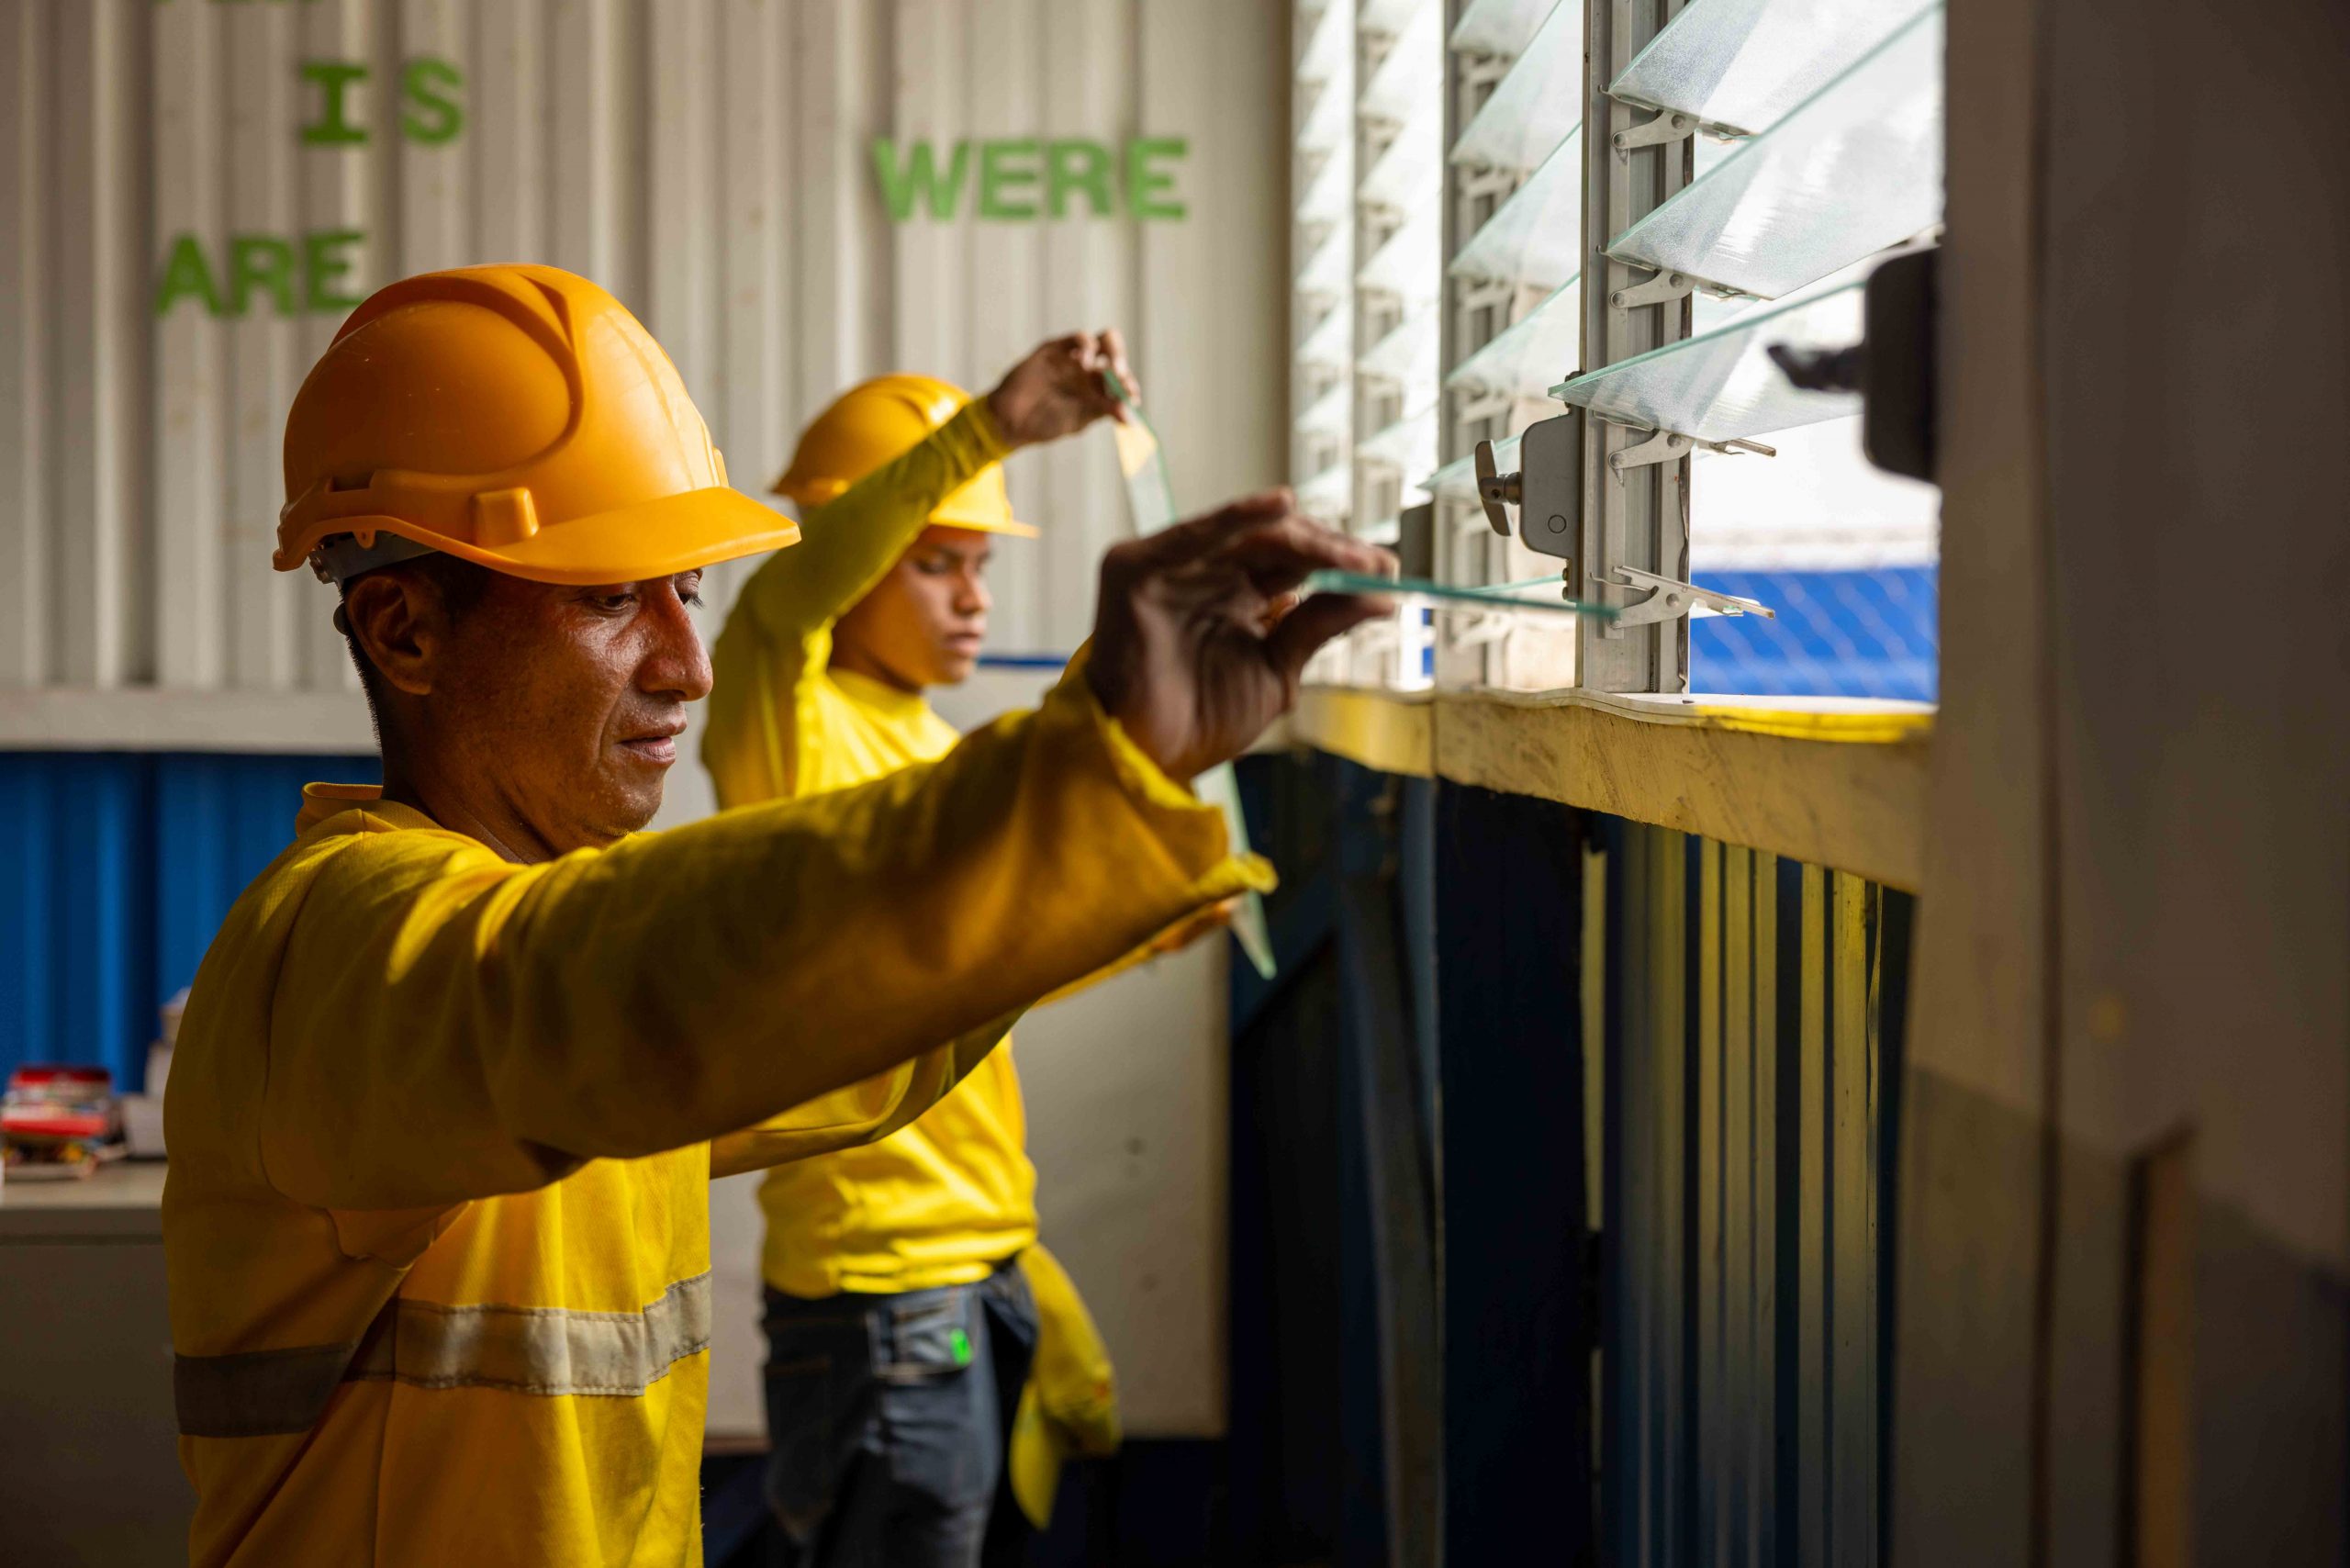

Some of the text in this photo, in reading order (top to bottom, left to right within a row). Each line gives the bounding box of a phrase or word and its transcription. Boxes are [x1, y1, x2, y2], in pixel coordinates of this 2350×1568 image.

[299, 58, 464, 147] IS
[873, 136, 1189, 222] WERE
[155, 230, 367, 319] ARE
